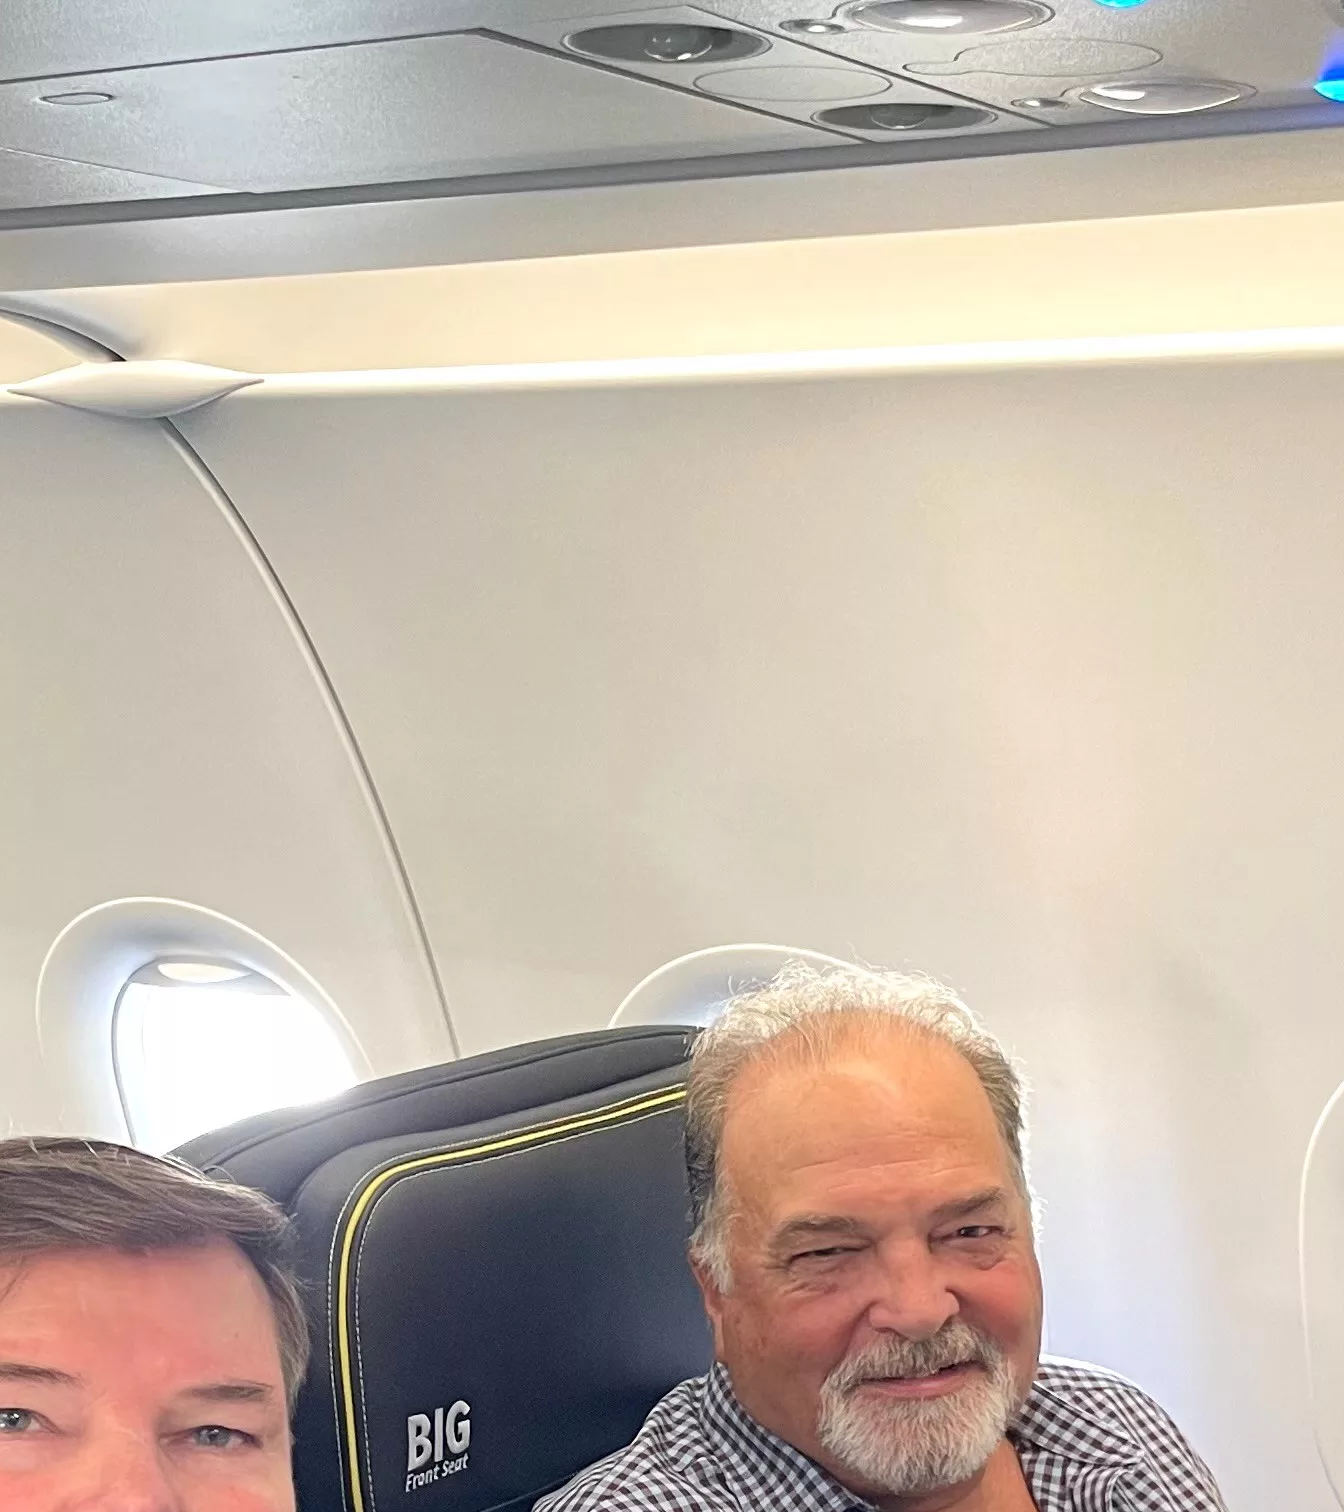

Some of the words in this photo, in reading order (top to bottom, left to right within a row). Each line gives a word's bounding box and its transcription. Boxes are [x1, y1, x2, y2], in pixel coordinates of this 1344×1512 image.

[407, 1400, 471, 1471] BIG
[405, 1464, 441, 1493] Front
[441, 1453, 469, 1477] Seat
